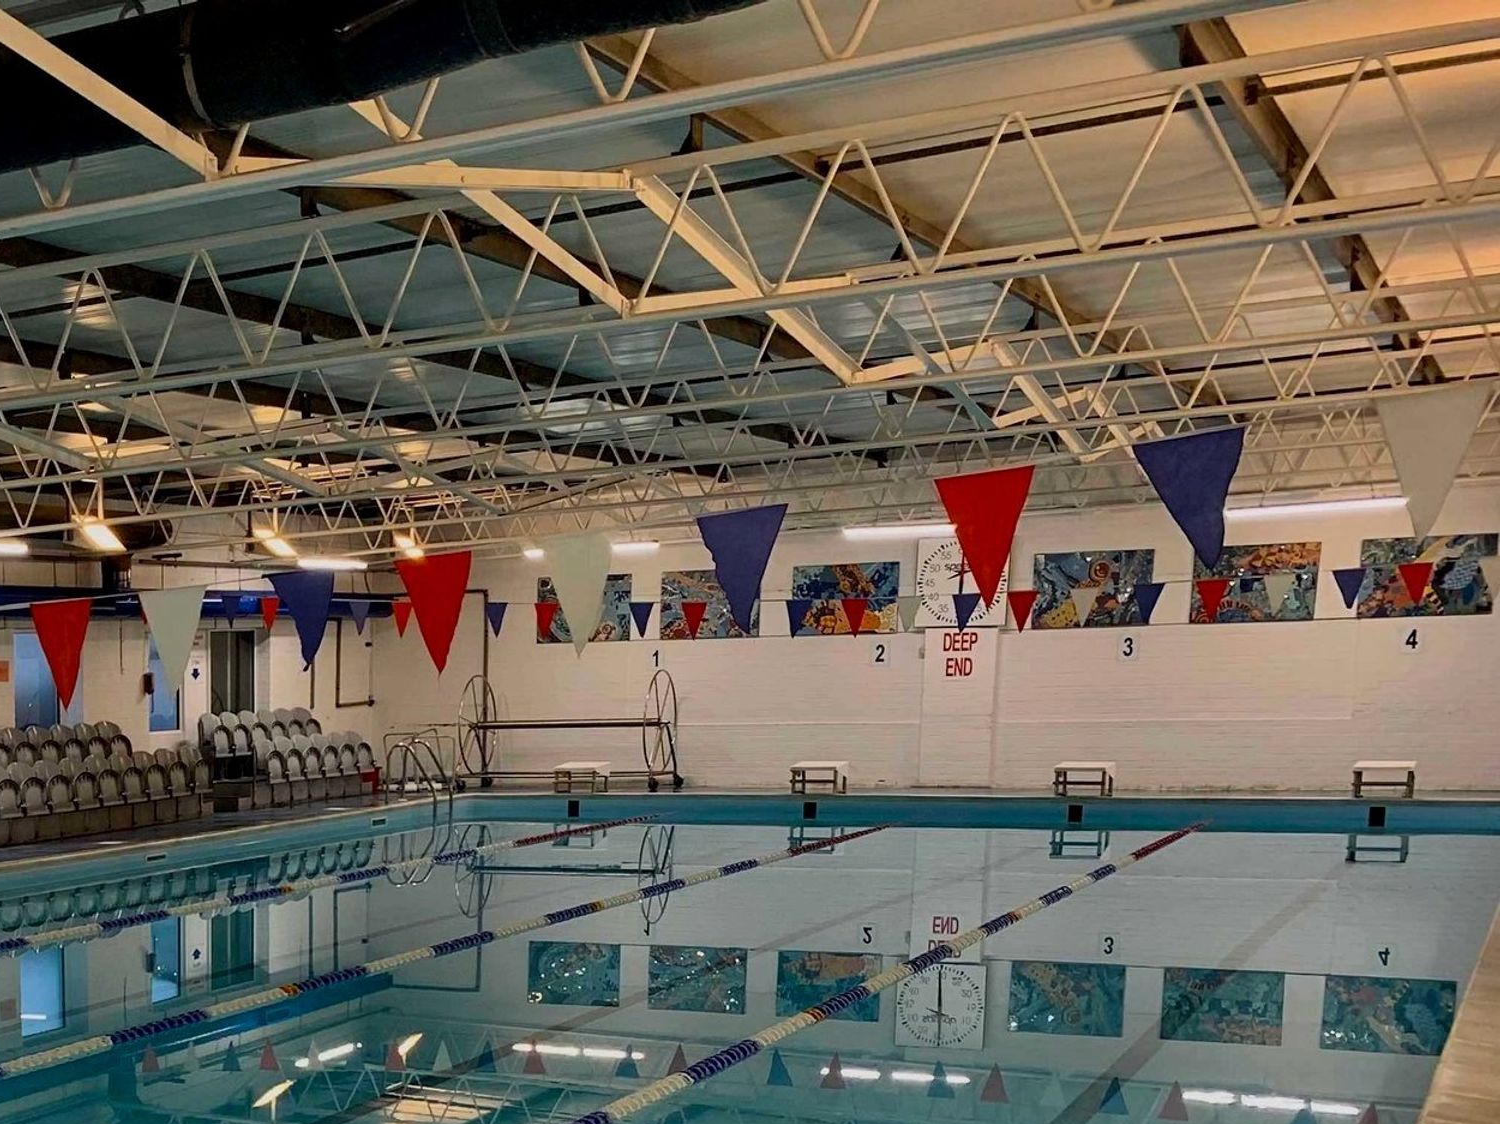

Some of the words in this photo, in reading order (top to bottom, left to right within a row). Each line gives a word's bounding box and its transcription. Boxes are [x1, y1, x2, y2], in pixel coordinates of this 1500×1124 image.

[929, 564, 941, 573] 50
[943, 632, 978, 651] DEEP
[1122, 637, 1133, 656] 3
[1405, 629, 1418, 649] 4
[652, 649, 659, 667] 1
[875, 644, 885, 662] 2
[945, 658, 973, 676] END
